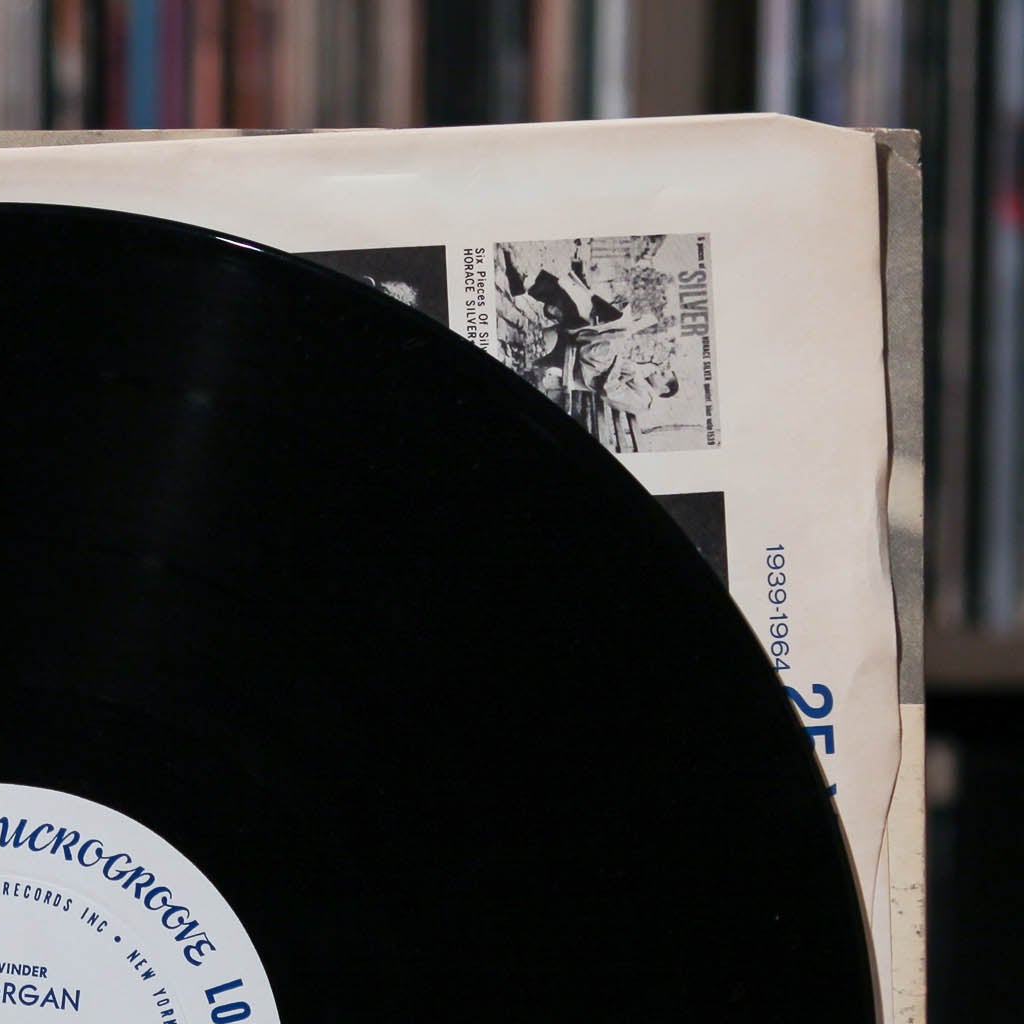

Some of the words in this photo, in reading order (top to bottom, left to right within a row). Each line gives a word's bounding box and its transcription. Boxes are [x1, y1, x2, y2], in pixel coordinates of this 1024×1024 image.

[463, 248, 475, 293] HORACE
[475, 248, 485, 264] Six
[477, 271, 486, 307] Pieces
[678, 271, 709, 337] SILVER
[465, 300, 477, 339] SILVER
[478, 313, 488, 325] Of
[704, 361, 712, 381] SILVER
[766, 543, 791, 672] 1939-1964
[2, 881, 73, 912] RECORDS
[80, 907, 108, 933] INC
[126, 949, 156, 981] NEW
